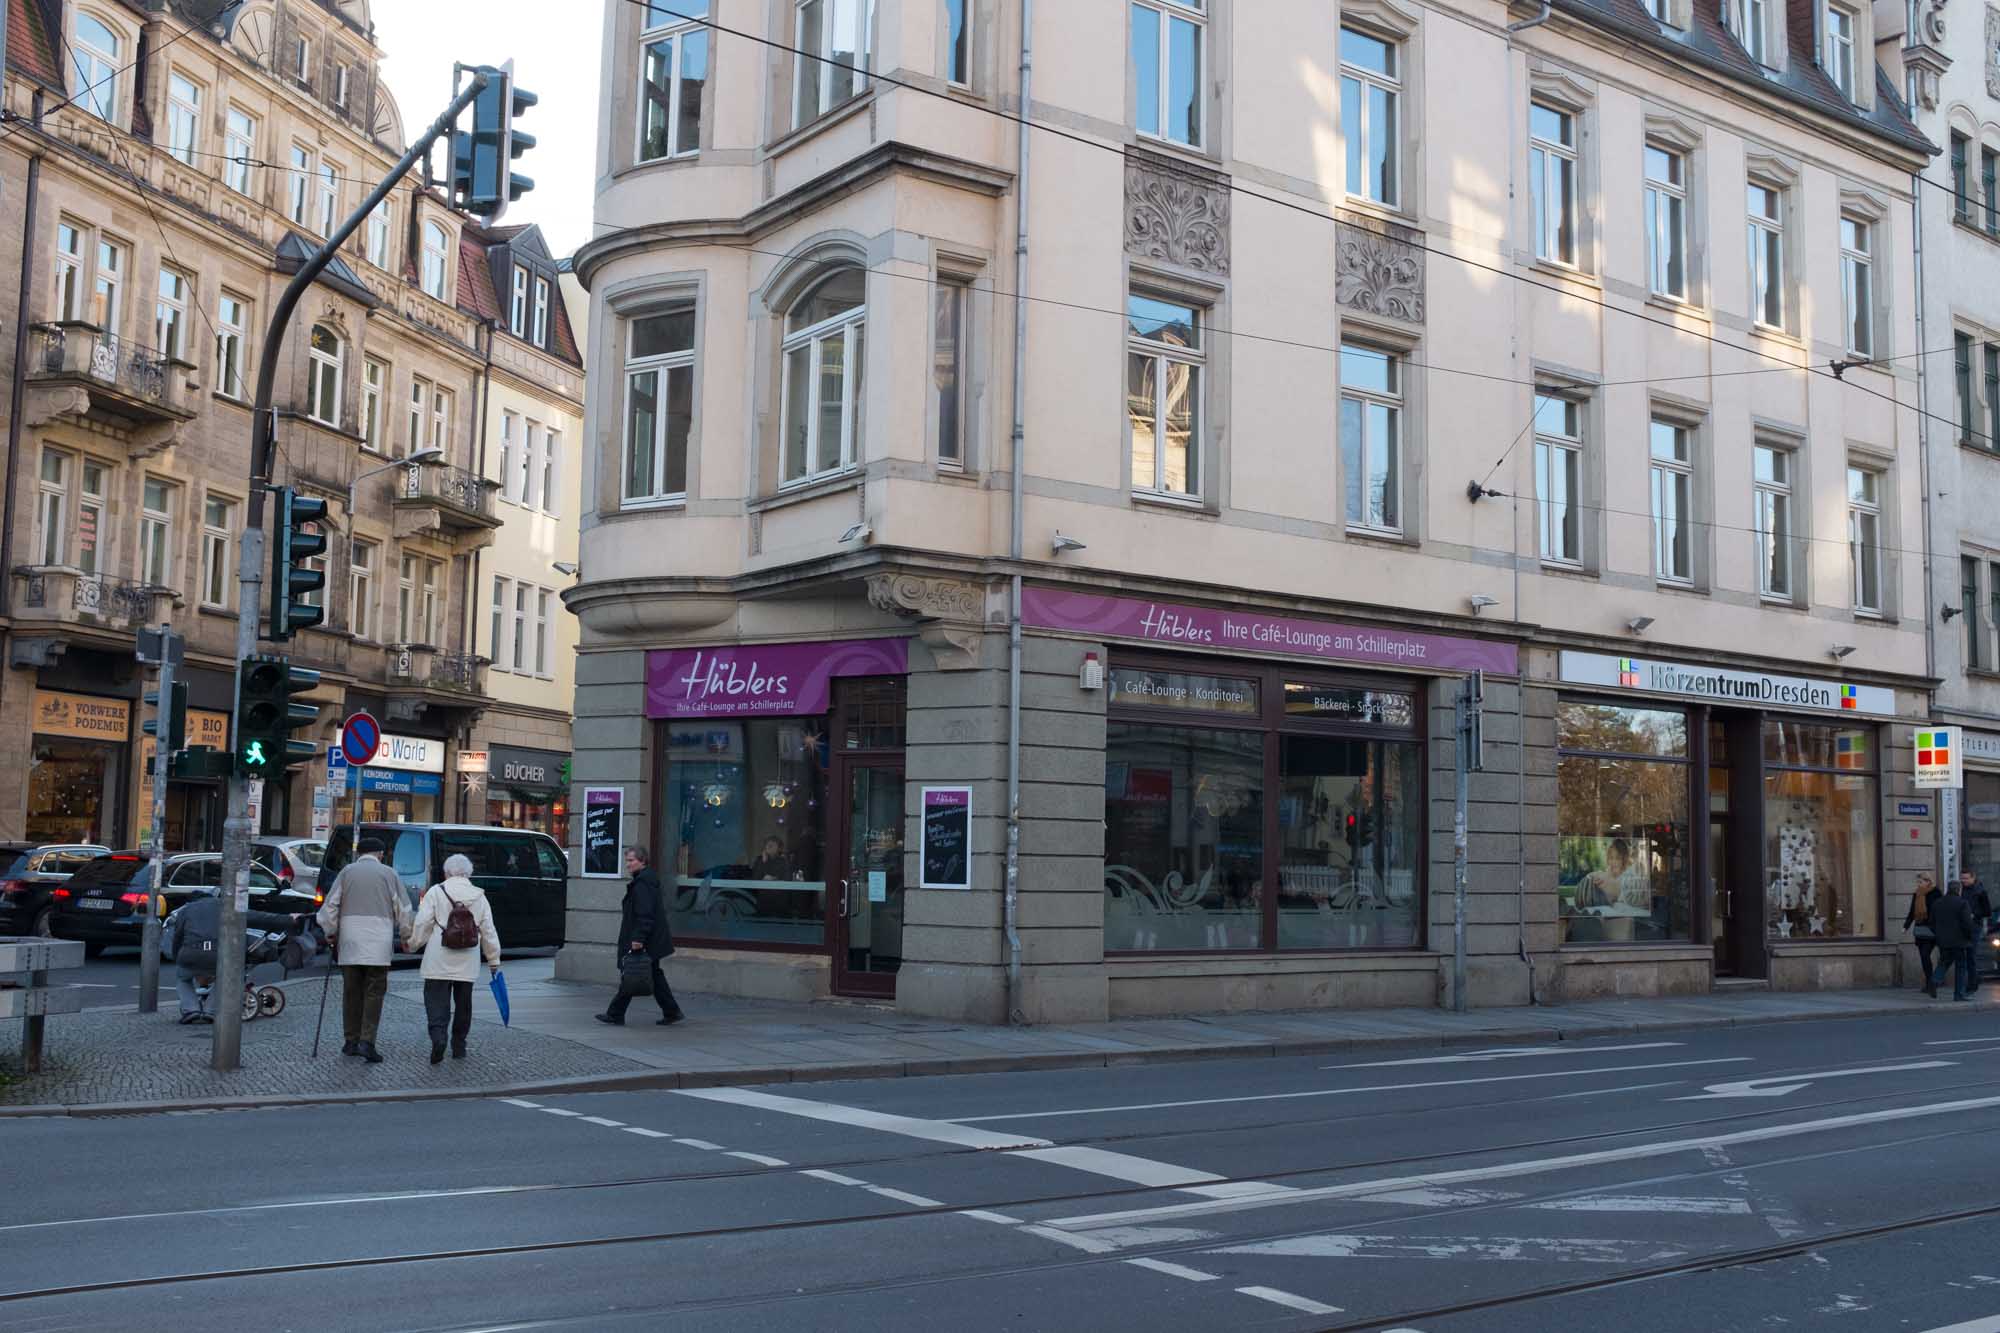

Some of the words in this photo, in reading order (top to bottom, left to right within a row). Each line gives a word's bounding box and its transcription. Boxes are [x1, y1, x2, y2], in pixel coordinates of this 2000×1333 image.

[1140, 604, 1212, 641] Hüblers
[1223, 619, 1248, 639] Ihre
[1252, 623, 1331, 651] Café-Lounge
[1335, 636, 1353, 650] am
[1357, 635, 1426, 659] Schillerplatz
[681, 651, 788, 699] Hüblers
[1125, 681, 1187, 700] Café-Lounge
[1195, 687, 1243, 703] Konditorei
[1651, 665, 1830, 705] HörzentrumDresden
[76, 704, 125, 719] VORWERK
[676, 704, 690, 712] Ihre
[692, 701, 735, 713] Café-Lounge
[737, 702, 748, 710] am
[750, 699, 795, 711] Schillerplatz
[1314, 697, 1349, 711] Bäckerei
[1357, 701, 1385, 714] Snacks
[75, 717, 125, 732] PODEMUS
[203, 719, 222, 732] BIO
[331, 748, 342, 765] P
[392, 738, 426, 761] World
[504, 761, 545, 782] BÜCHER
